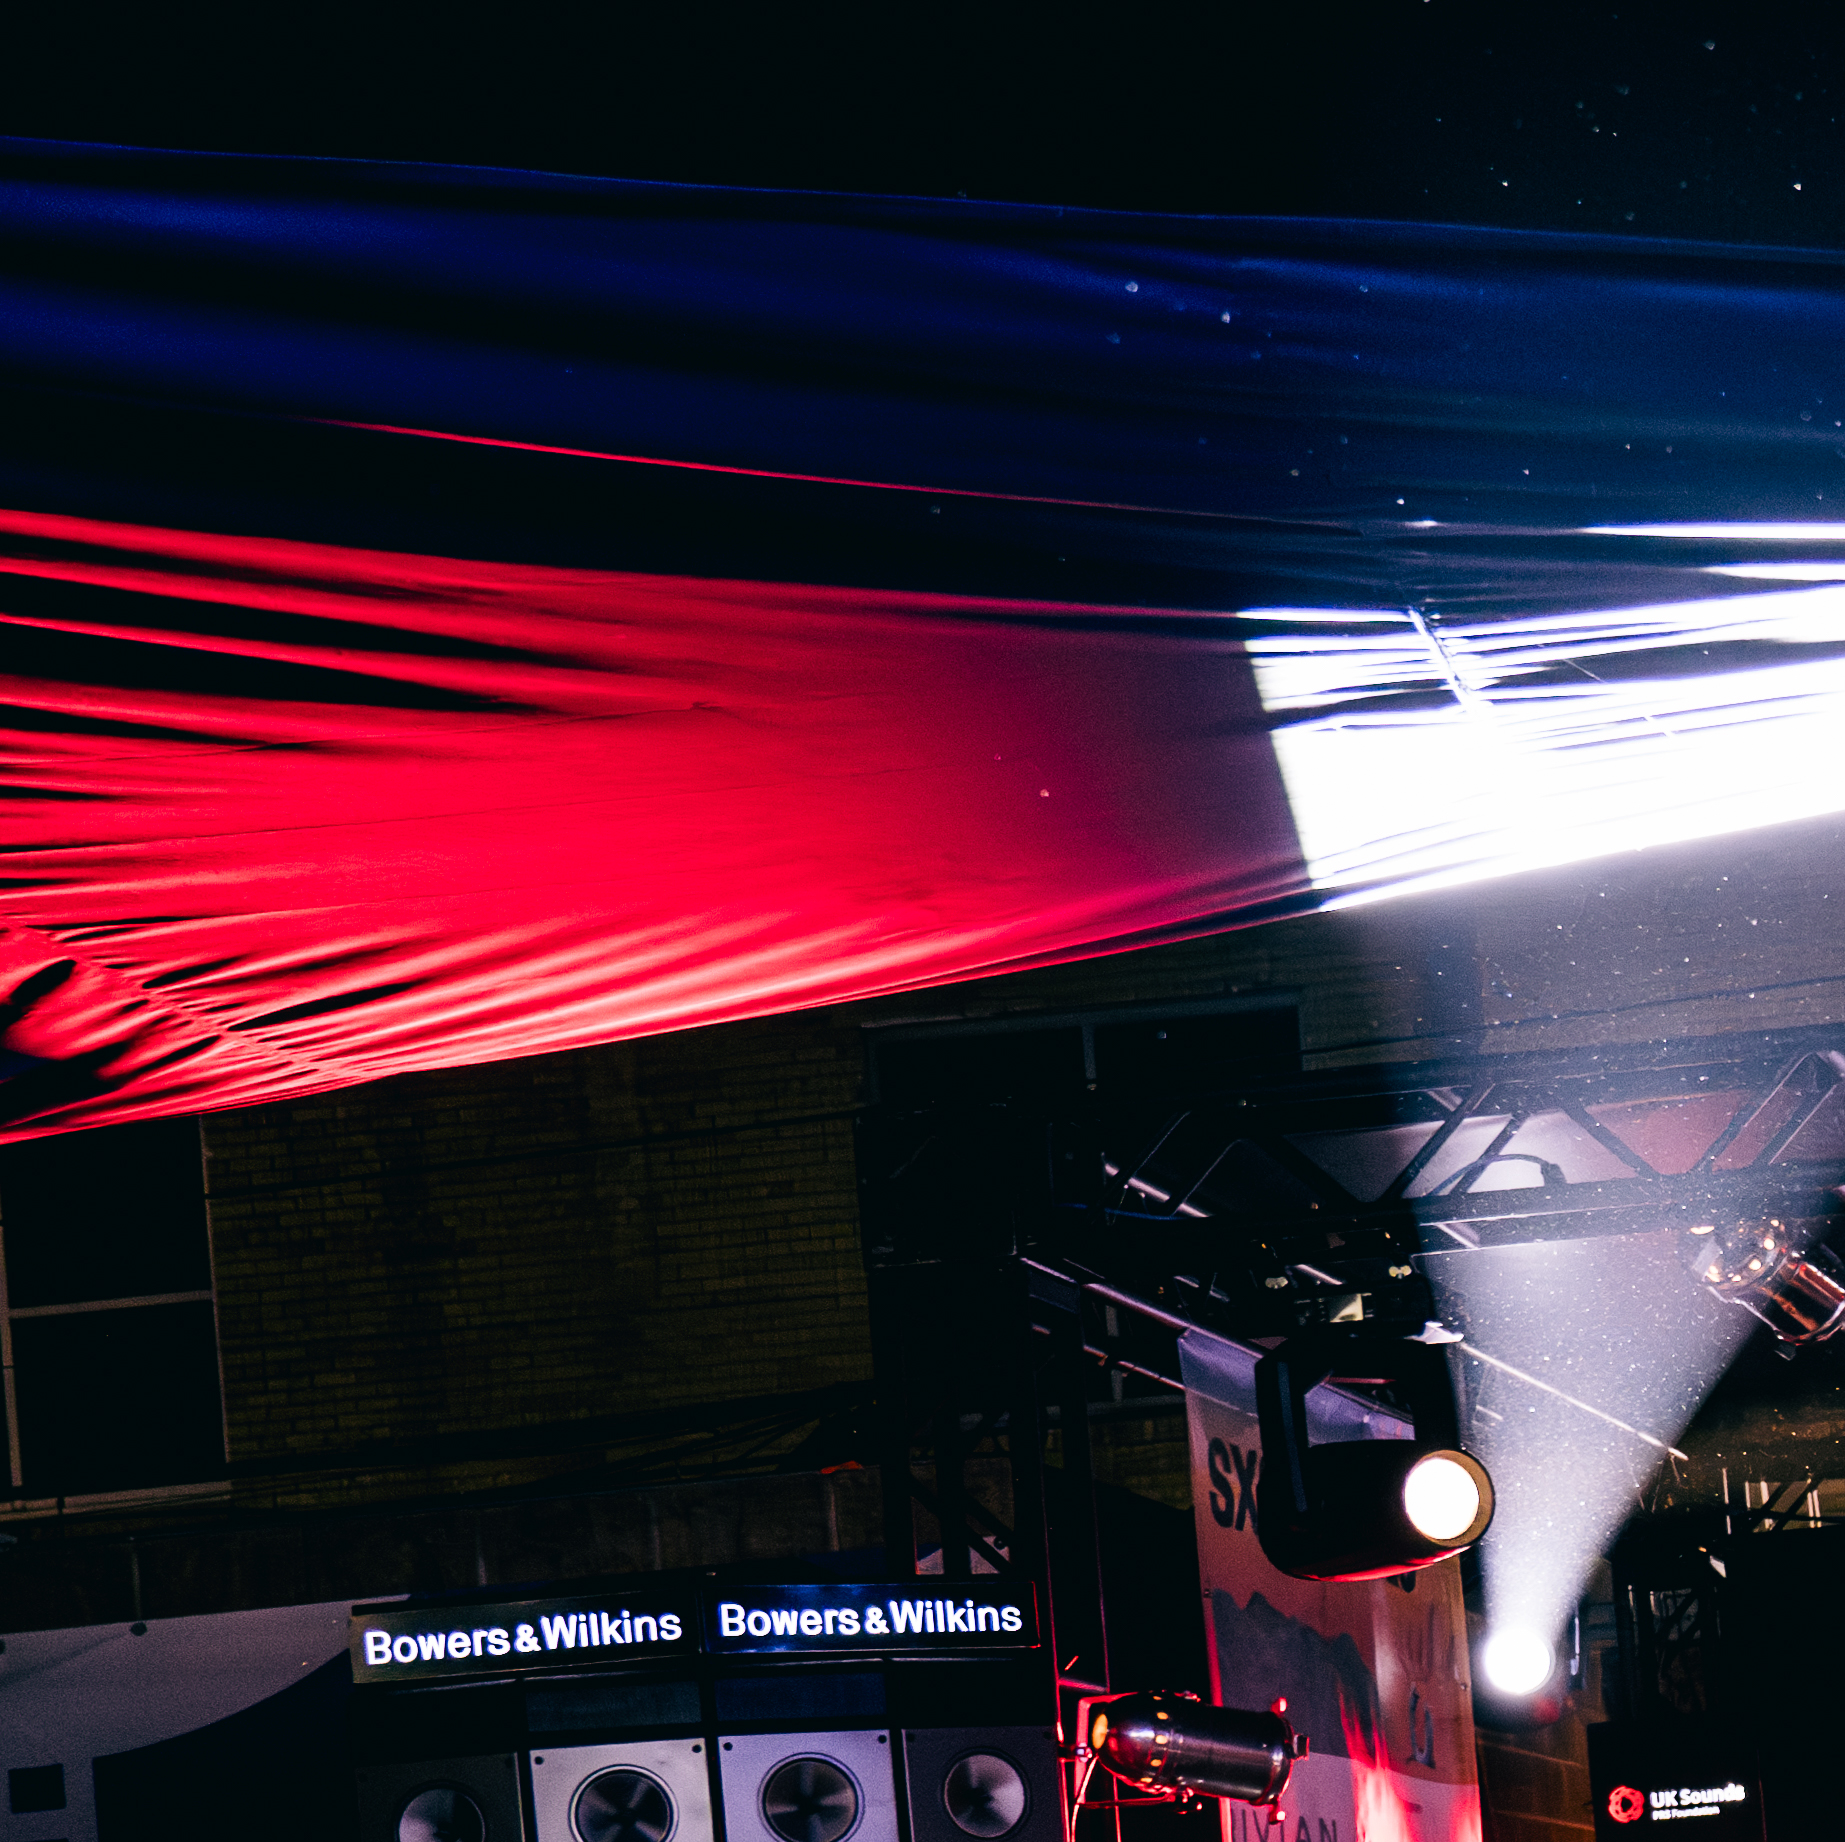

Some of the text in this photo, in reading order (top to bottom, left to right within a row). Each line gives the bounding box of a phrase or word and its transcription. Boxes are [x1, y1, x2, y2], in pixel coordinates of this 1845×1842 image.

[1208, 1437, 1260, 1532] SX
[1650, 1782, 1746, 1808] UK Sounds
